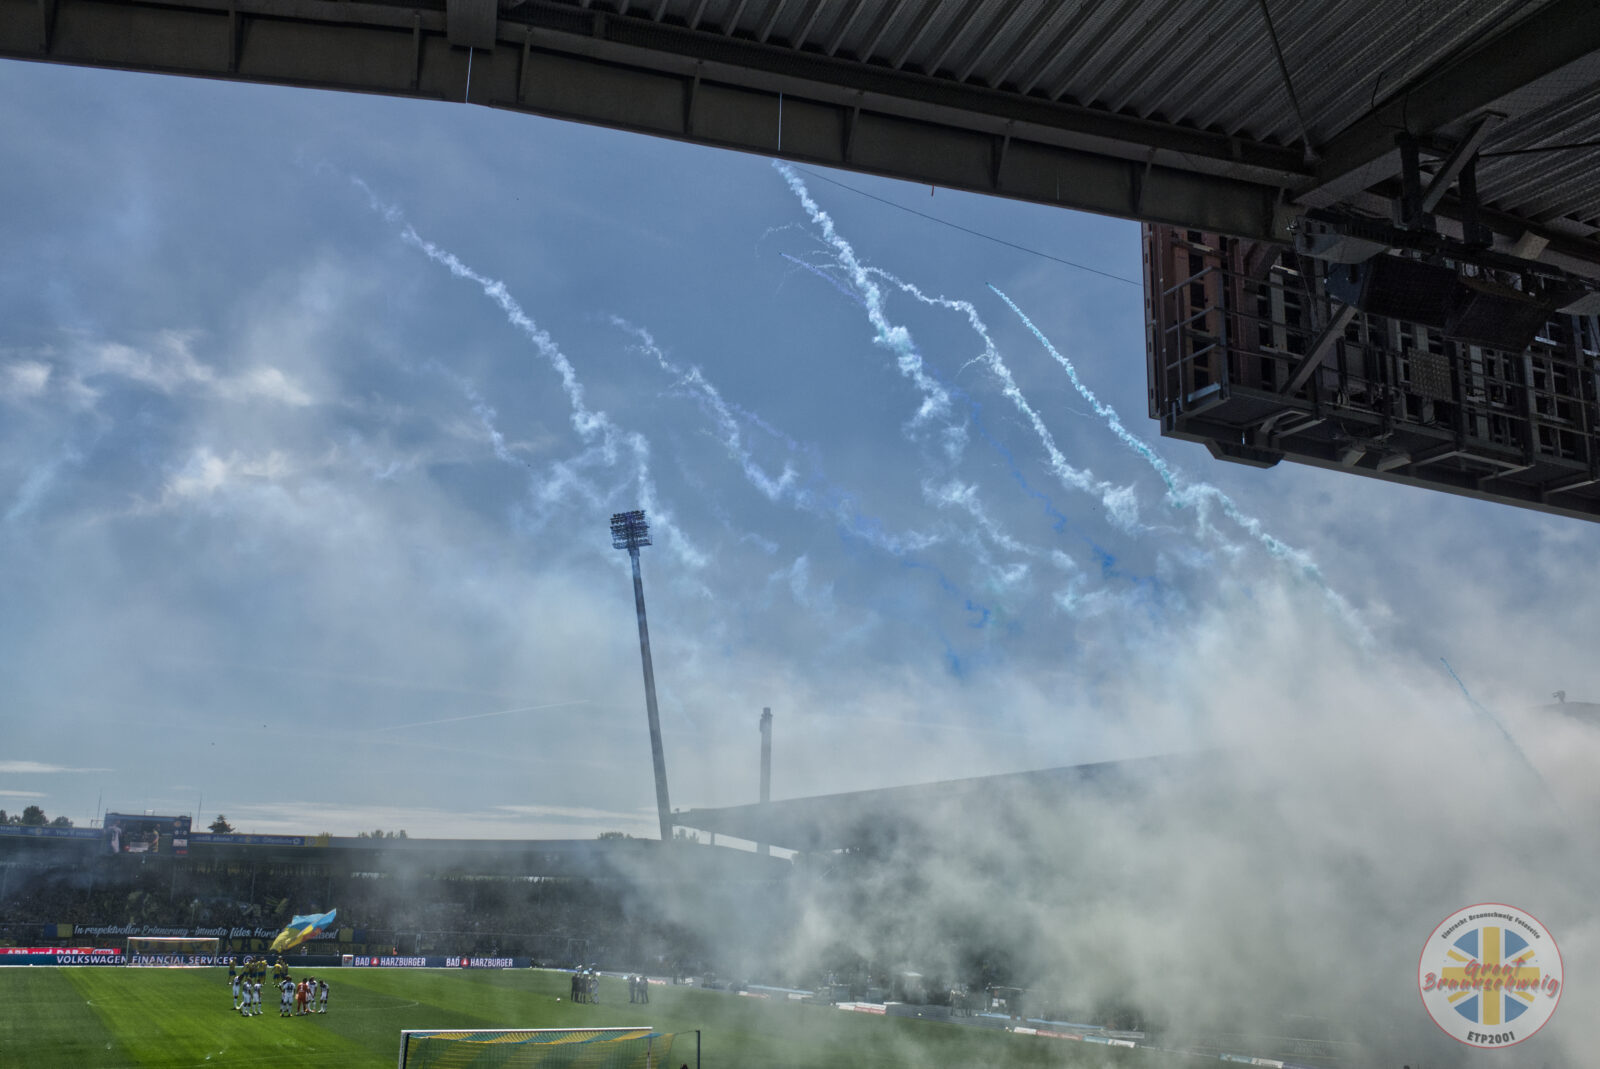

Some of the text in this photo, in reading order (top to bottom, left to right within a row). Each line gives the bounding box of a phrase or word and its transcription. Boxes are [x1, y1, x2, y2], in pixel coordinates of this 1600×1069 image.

[74, 925, 84, 935] In
[141, 925, 189, 938] Erinnerung
[56, 955, 234, 965] VOLKSWAGEN FINANCIAL SERVICES
[354, 957, 370, 967] BAD
[380, 957, 426, 967] HARZBURGER
[445, 957, 513, 967] BAD HARZBURGER
